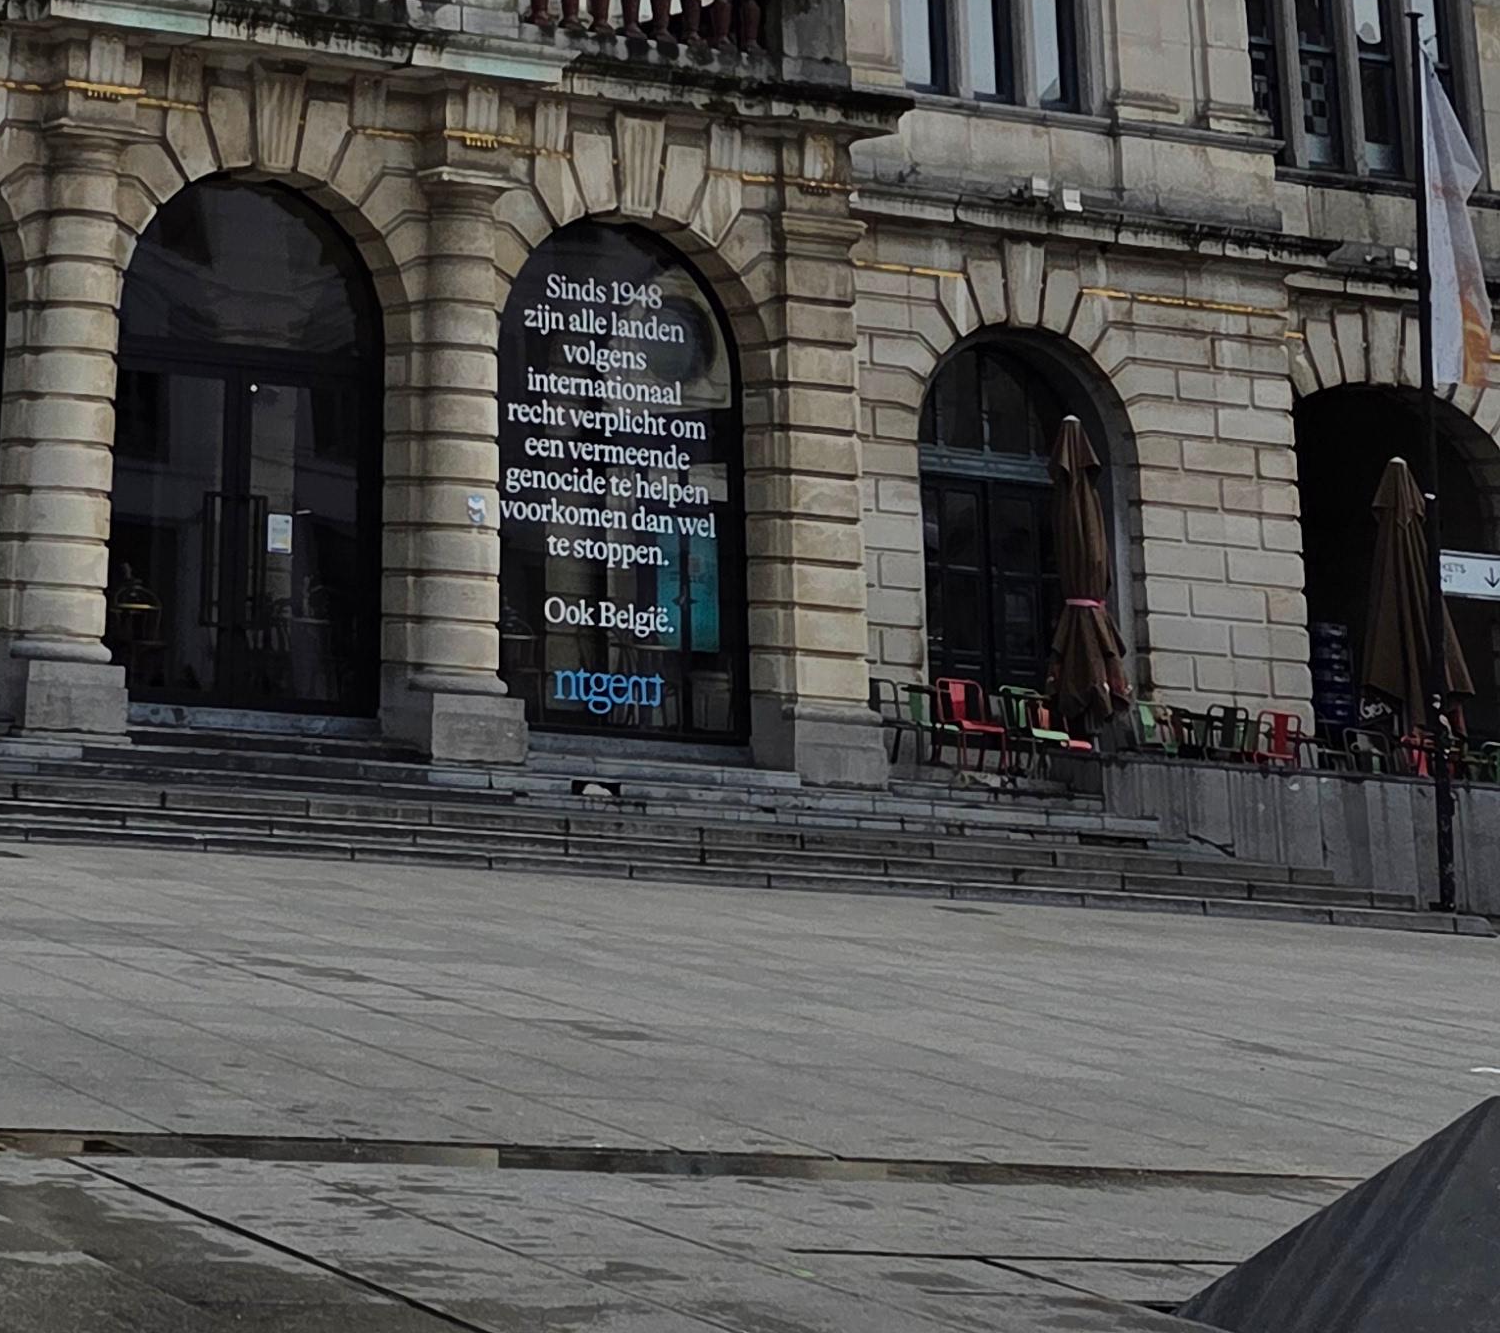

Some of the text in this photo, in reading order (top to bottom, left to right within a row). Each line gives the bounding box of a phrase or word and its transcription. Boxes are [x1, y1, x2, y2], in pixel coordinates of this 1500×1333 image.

[546, 274, 662, 309] Sinds 1948
[524, 304, 684, 343] zijn alle landen
[563, 339, 646, 372] volgens
[527, 367, 681, 406] internationaal
[508, 400, 705, 439] recht verplicht om
[525, 436, 690, 470] een vermeende
[506, 466, 708, 508] genocide te helpen
[500, 497, 716, 538] voorkomen dan wel
[547, 534, 668, 568] te stoppen.
[544, 596, 674, 637] Ook België.
